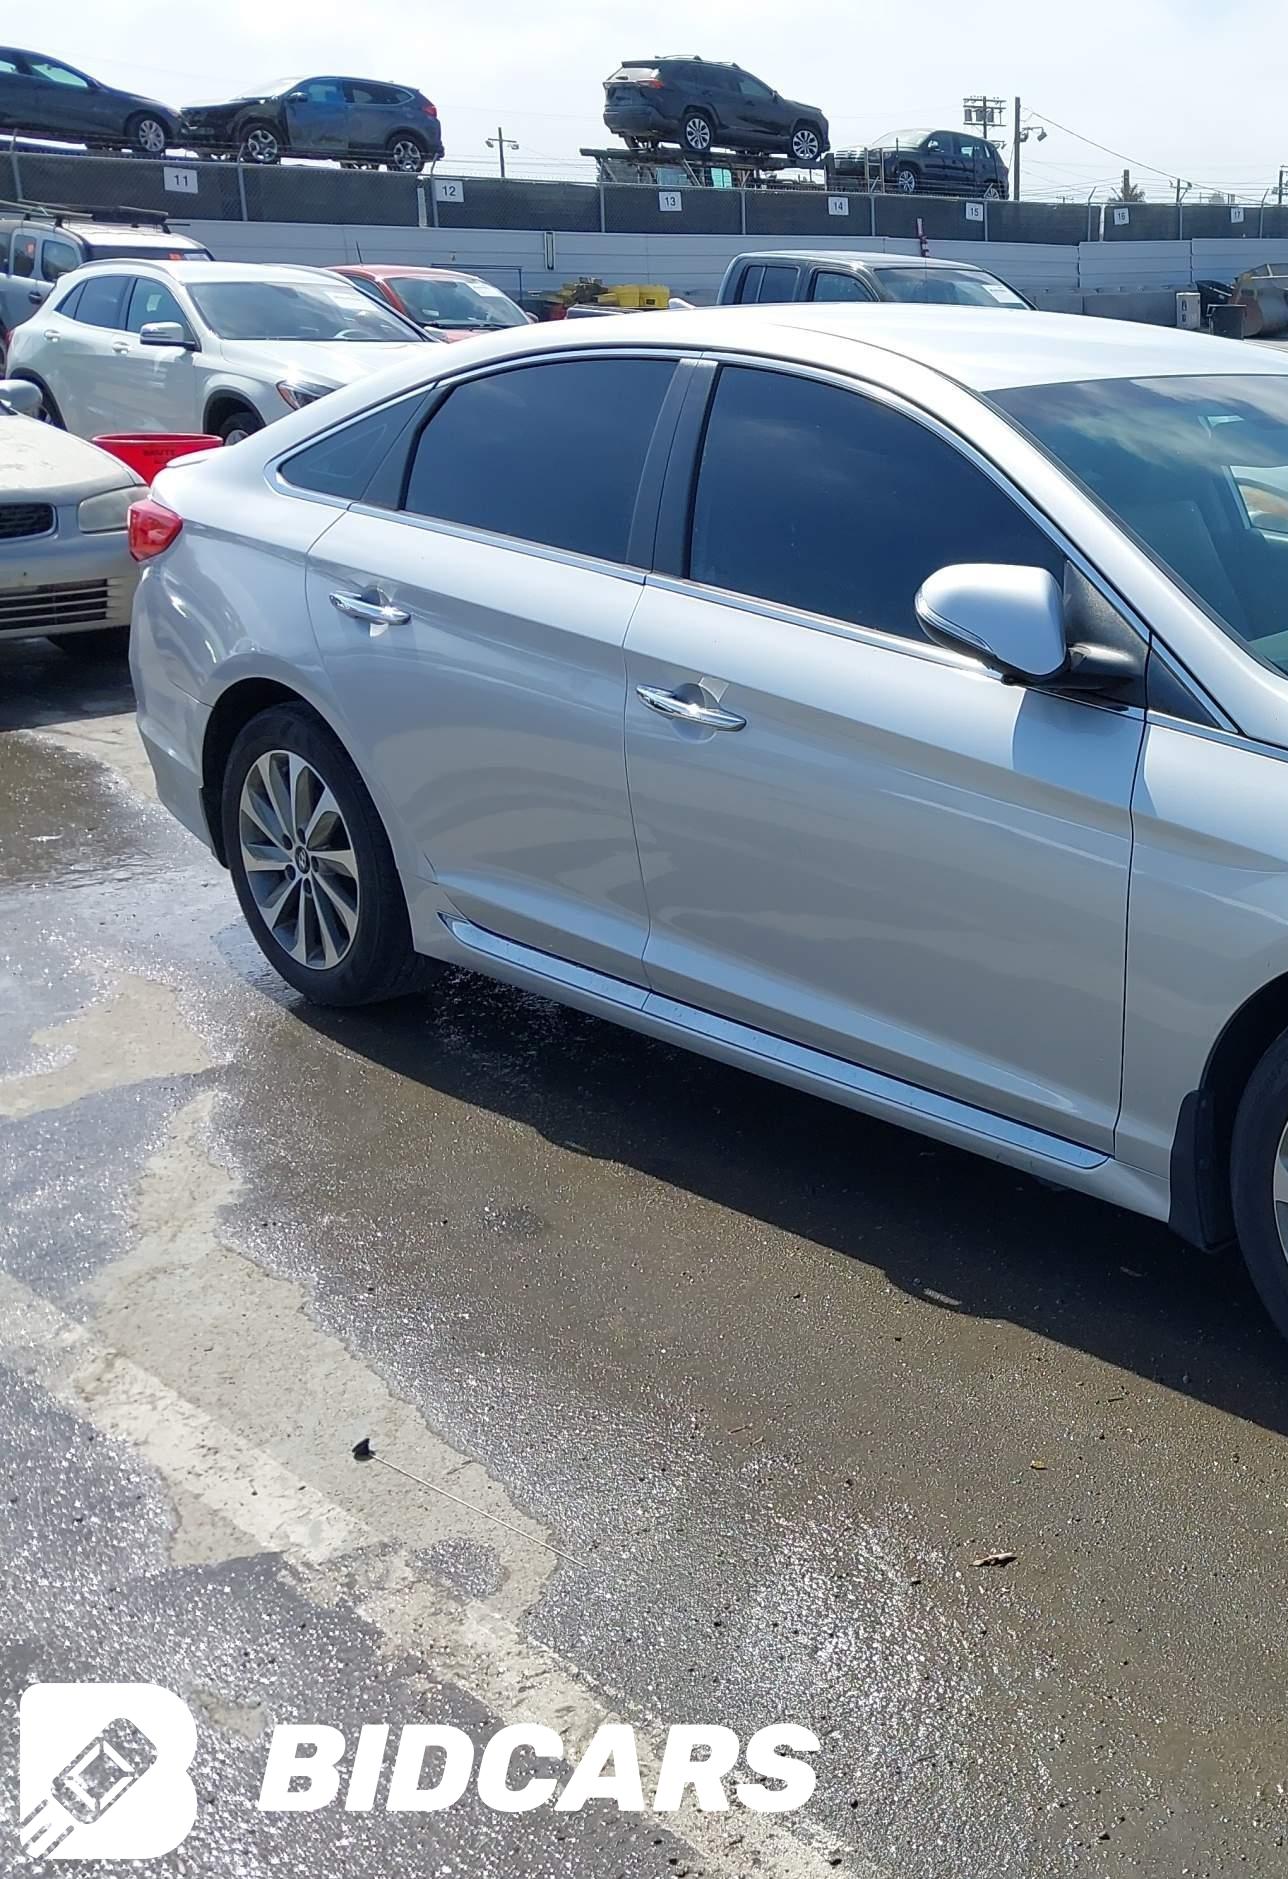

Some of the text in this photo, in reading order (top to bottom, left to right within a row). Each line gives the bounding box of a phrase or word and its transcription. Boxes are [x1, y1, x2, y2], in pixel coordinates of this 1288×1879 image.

[173, 174, 188, 187] 11
[441, 184, 457, 197] 12
[664, 195, 677, 207] 13
[833, 200, 844, 211] 14
[970, 207, 980, 217] 15
[1117, 211, 1126, 221] 16
